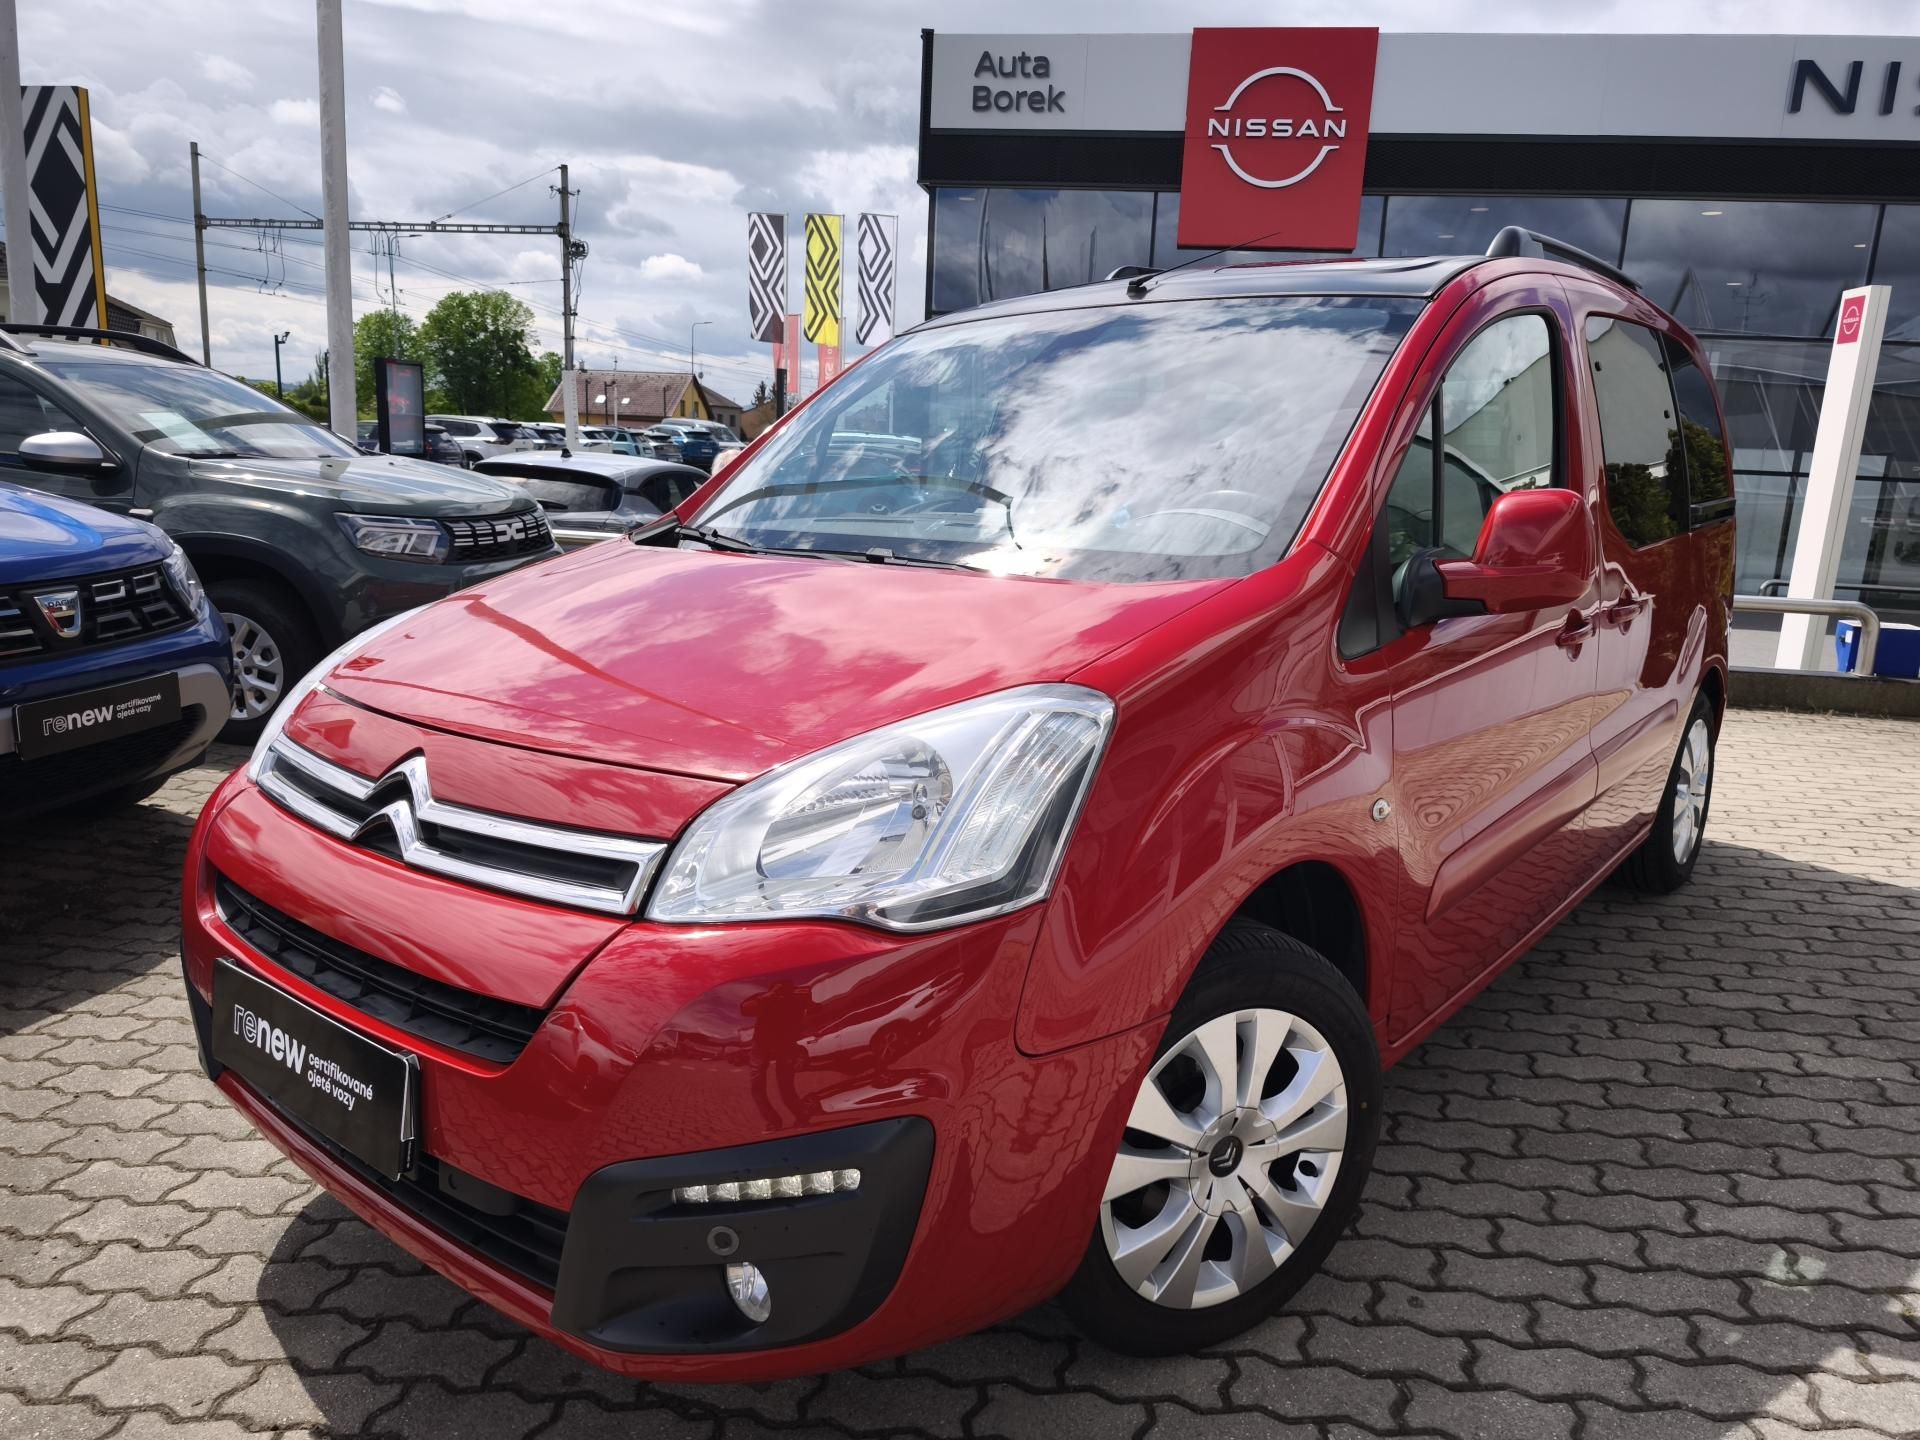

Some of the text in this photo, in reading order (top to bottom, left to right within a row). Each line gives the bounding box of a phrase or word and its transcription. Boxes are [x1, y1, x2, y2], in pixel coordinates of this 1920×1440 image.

[974, 50, 1051, 78] Auta
[971, 84, 1066, 114] Borek
[1787, 59, 1920, 116] NI
[1207, 118, 1347, 138] NISSAN
[42, 693, 161, 736] renew certifikované
[116, 704, 152, 719] ojeté vozy
[234, 1004, 374, 1101] renew certifikované
[307, 1069, 356, 1111] ojeté vozy
